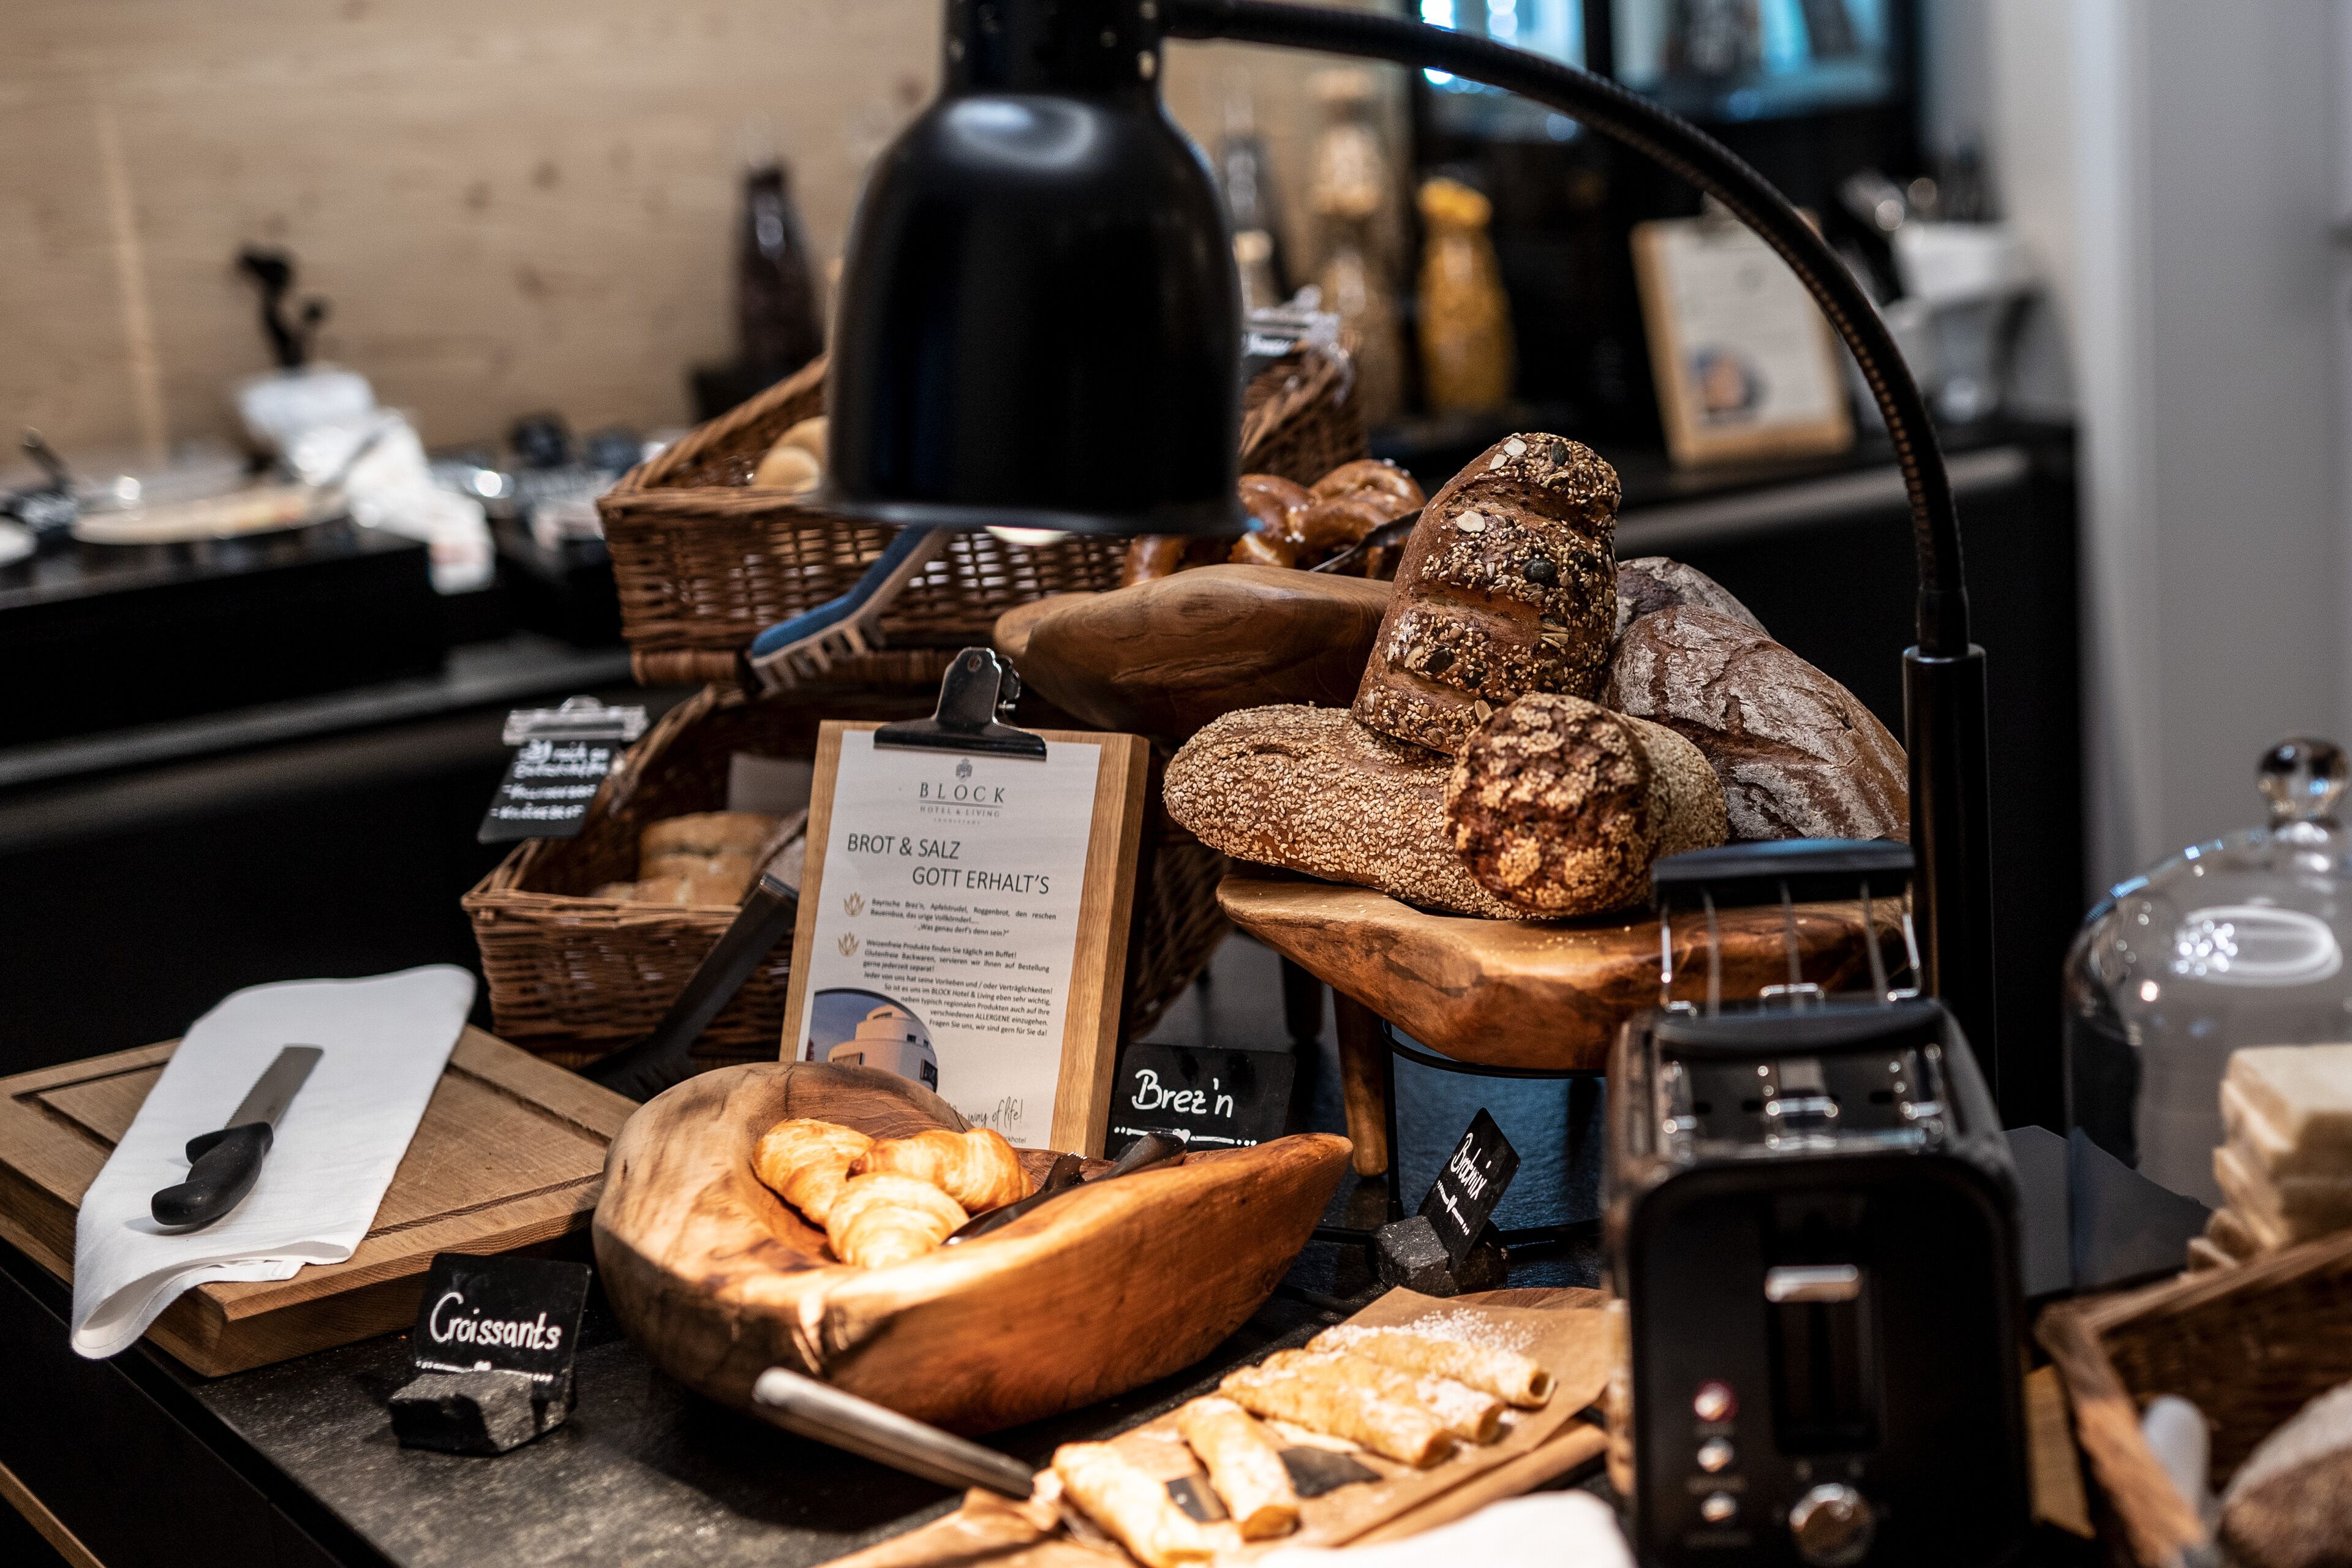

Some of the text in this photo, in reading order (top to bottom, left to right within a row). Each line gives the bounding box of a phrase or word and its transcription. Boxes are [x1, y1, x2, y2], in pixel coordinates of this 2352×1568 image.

[920, 782, 1006, 804] BLOCK
[921, 805, 950, 814] HOTEL
[966, 809, 1000, 818] LIVING
[848, 833, 960, 859] BROT & SALZ
[913, 867, 962, 887] GOTT
[973, 907, 1009, 917] Roggenbrot,
[903, 942, 930, 951] Produkte
[963, 947, 982, 956] täglich
[865, 949, 898, 959] Glutenfreie
[902, 952, 935, 963] Backwaren,
[1018, 963, 1049, 973] Bestellung
[931, 987, 950, 995] BLOCK
[977, 991, 993, 1000] Living
[935, 977, 963, 986] Vorlieben
[999, 982, 1052, 994] Verträglichkeiten!
[921, 997, 941, 1006] typisch
[944, 1000, 975, 1009] regionalen
[977, 1002, 1008, 1011] Produkten
[929, 1018, 949, 1027] Fragen
[930, 1009, 1047, 1027] verschiedenen ALLERGENE einzugehen.
[1132, 1069, 1234, 1118] Brez'n
[992, 1099, 1005, 1131] of
[1004, 1096, 1023, 1132] life!
[429, 1292, 563, 1350] Croissants
